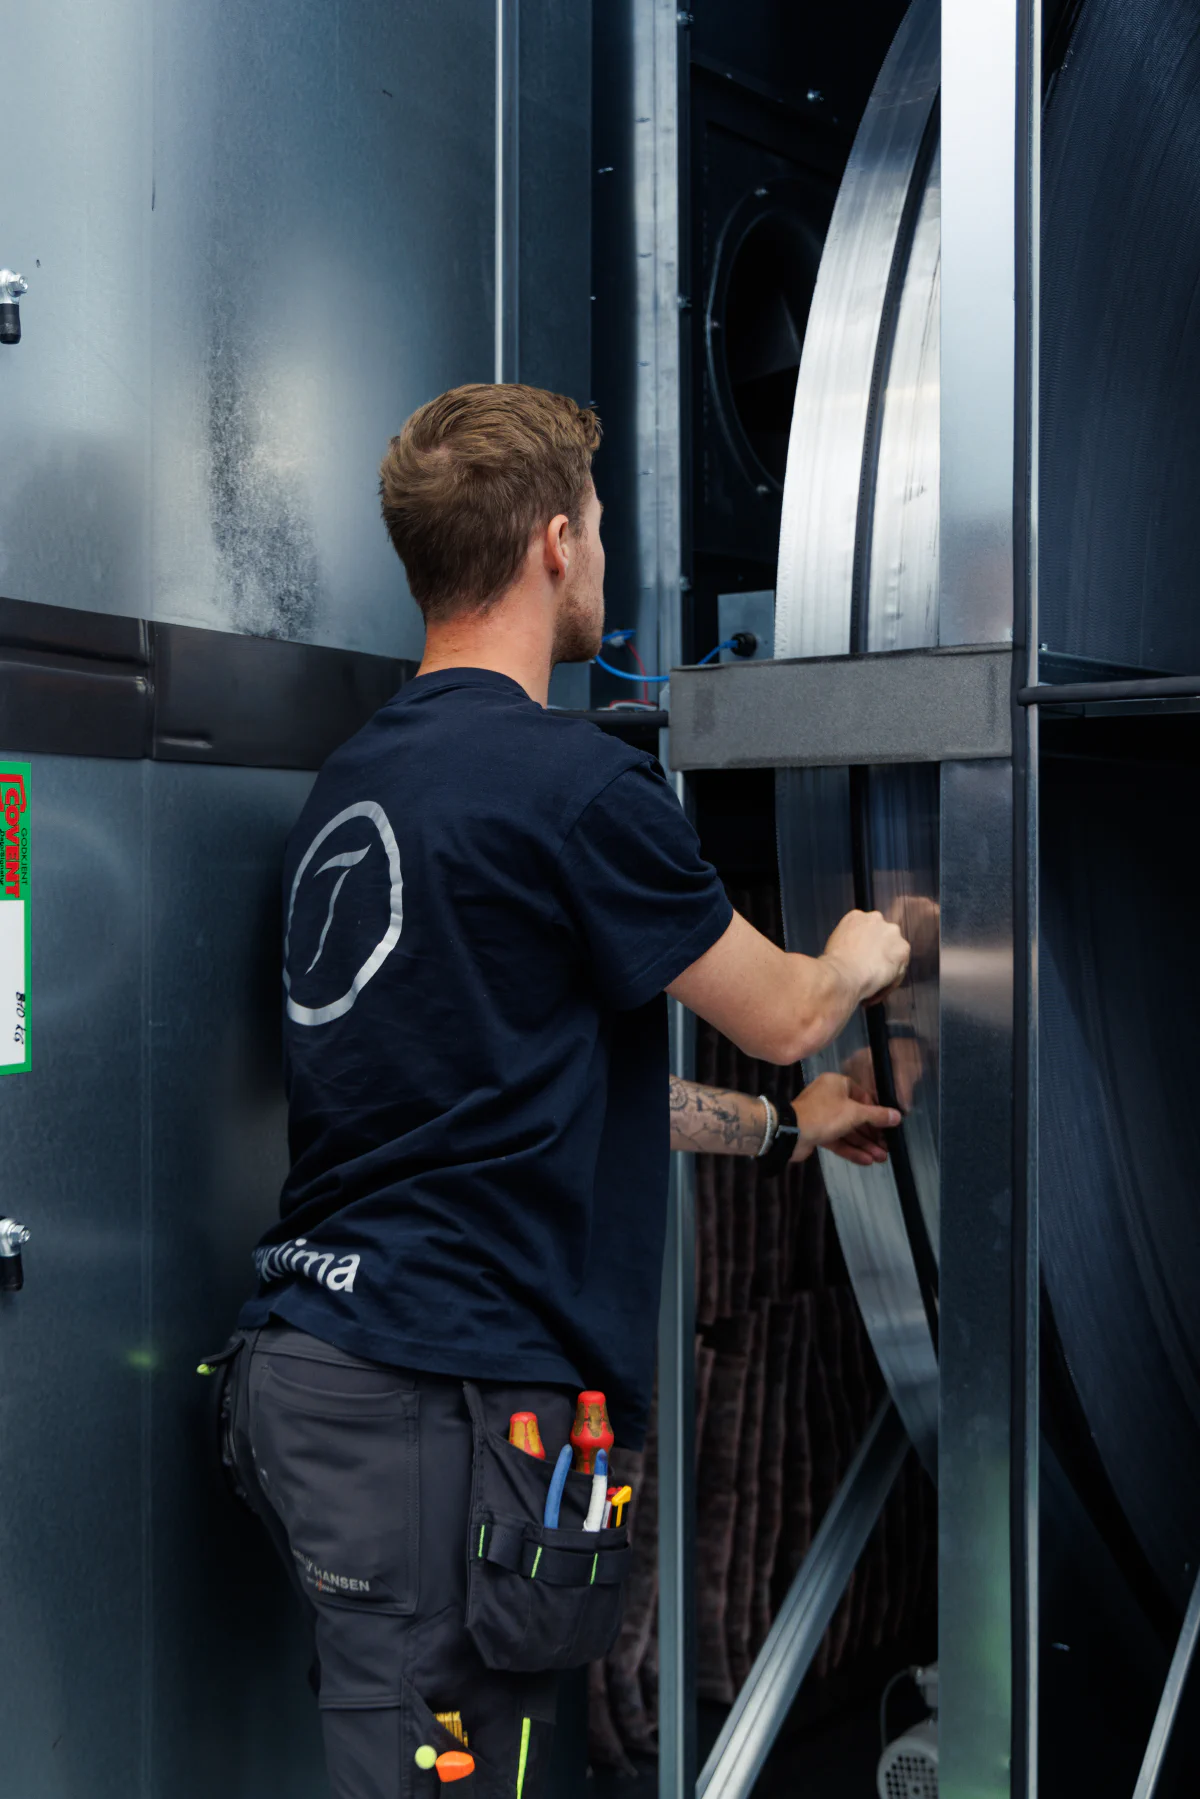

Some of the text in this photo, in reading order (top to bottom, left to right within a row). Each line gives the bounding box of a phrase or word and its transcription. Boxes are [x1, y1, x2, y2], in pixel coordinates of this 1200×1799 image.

[5, 787, 20, 898] COVENT
[20, 827, 28, 885] GODKJENT
[314, 1565, 371, 1592] HANSEN
